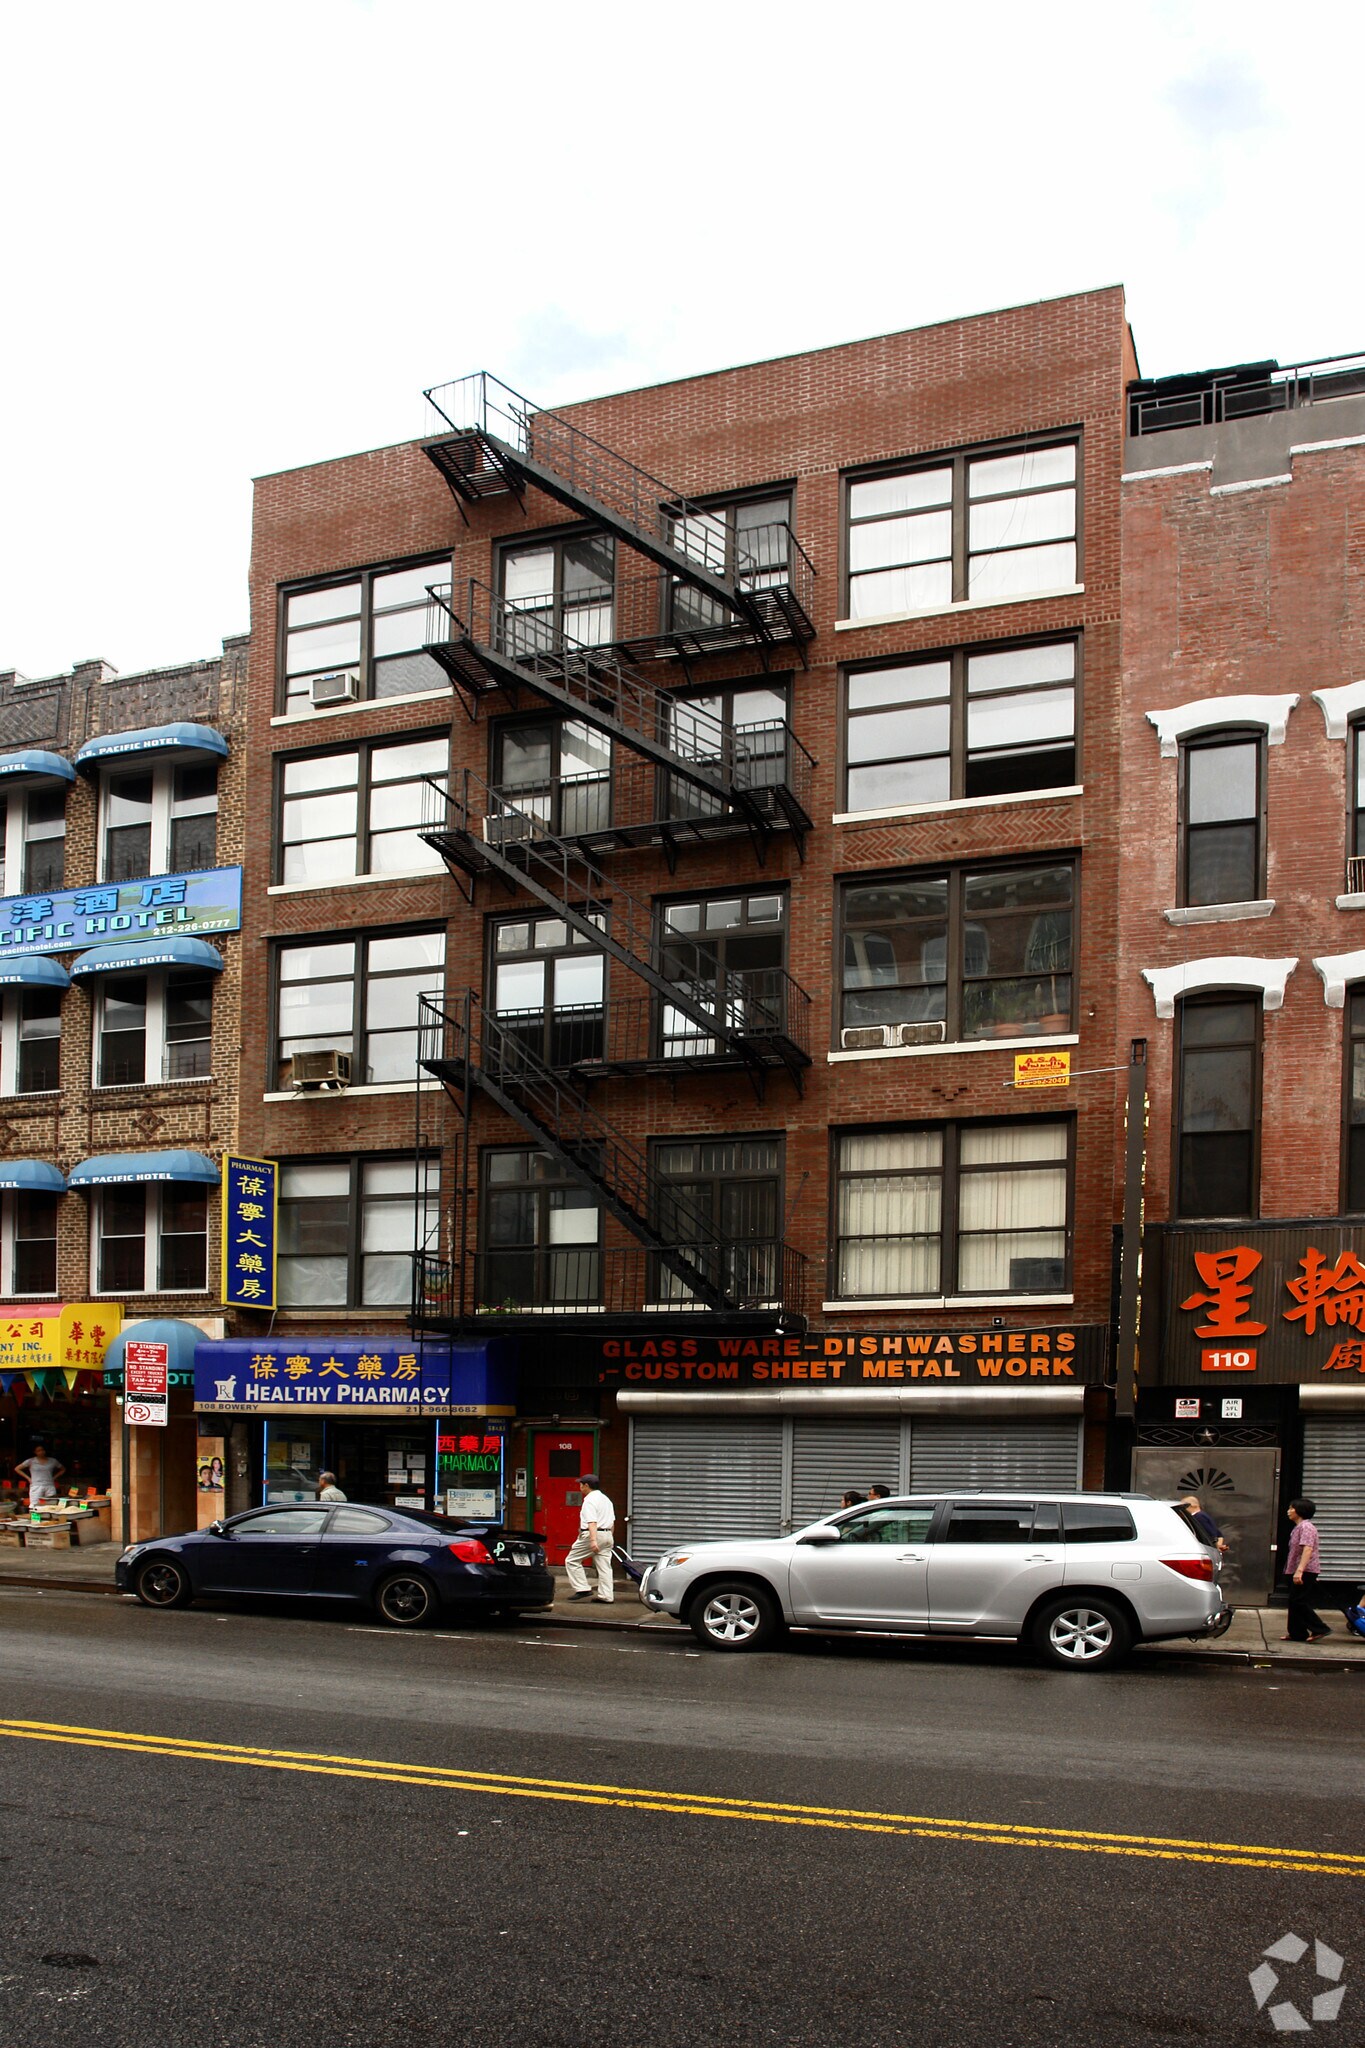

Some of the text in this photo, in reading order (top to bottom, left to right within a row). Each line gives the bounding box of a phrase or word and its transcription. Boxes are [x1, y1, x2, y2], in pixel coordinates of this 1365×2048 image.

[99, 742, 141, 755] PACIFIC
[143, 737, 181, 748] HOTEL
[0, 763, 28, 773] OTEL
[11, 880, 186, 924] 洋酒店
[85, 906, 194, 934] HOTEL
[153, 919, 230, 936] 212-226-0777
[0, 941, 72, 956] pacifichotel.com
[74, 954, 176, 974] U.S. PACIFIC HOTEL
[231, 1161, 272, 1175] PHARMACY
[71, 1172, 173, 1185] U.S. PACIFIC HOTEL
[602, 1339, 698, 1357] GLASS
[752, 1360, 846, 1379] SHEET
[862, 1359, 961, 1378] METAL
[976, 1357, 1074, 1377] WORK
[1208, 1352, 1250, 1367] 110
[245, 1383, 451, 1403] HEALTHY PHARMACY
[218, 1403, 258, 1411] BOWERY
[438, 1455, 501, 1472] PHARMACY
